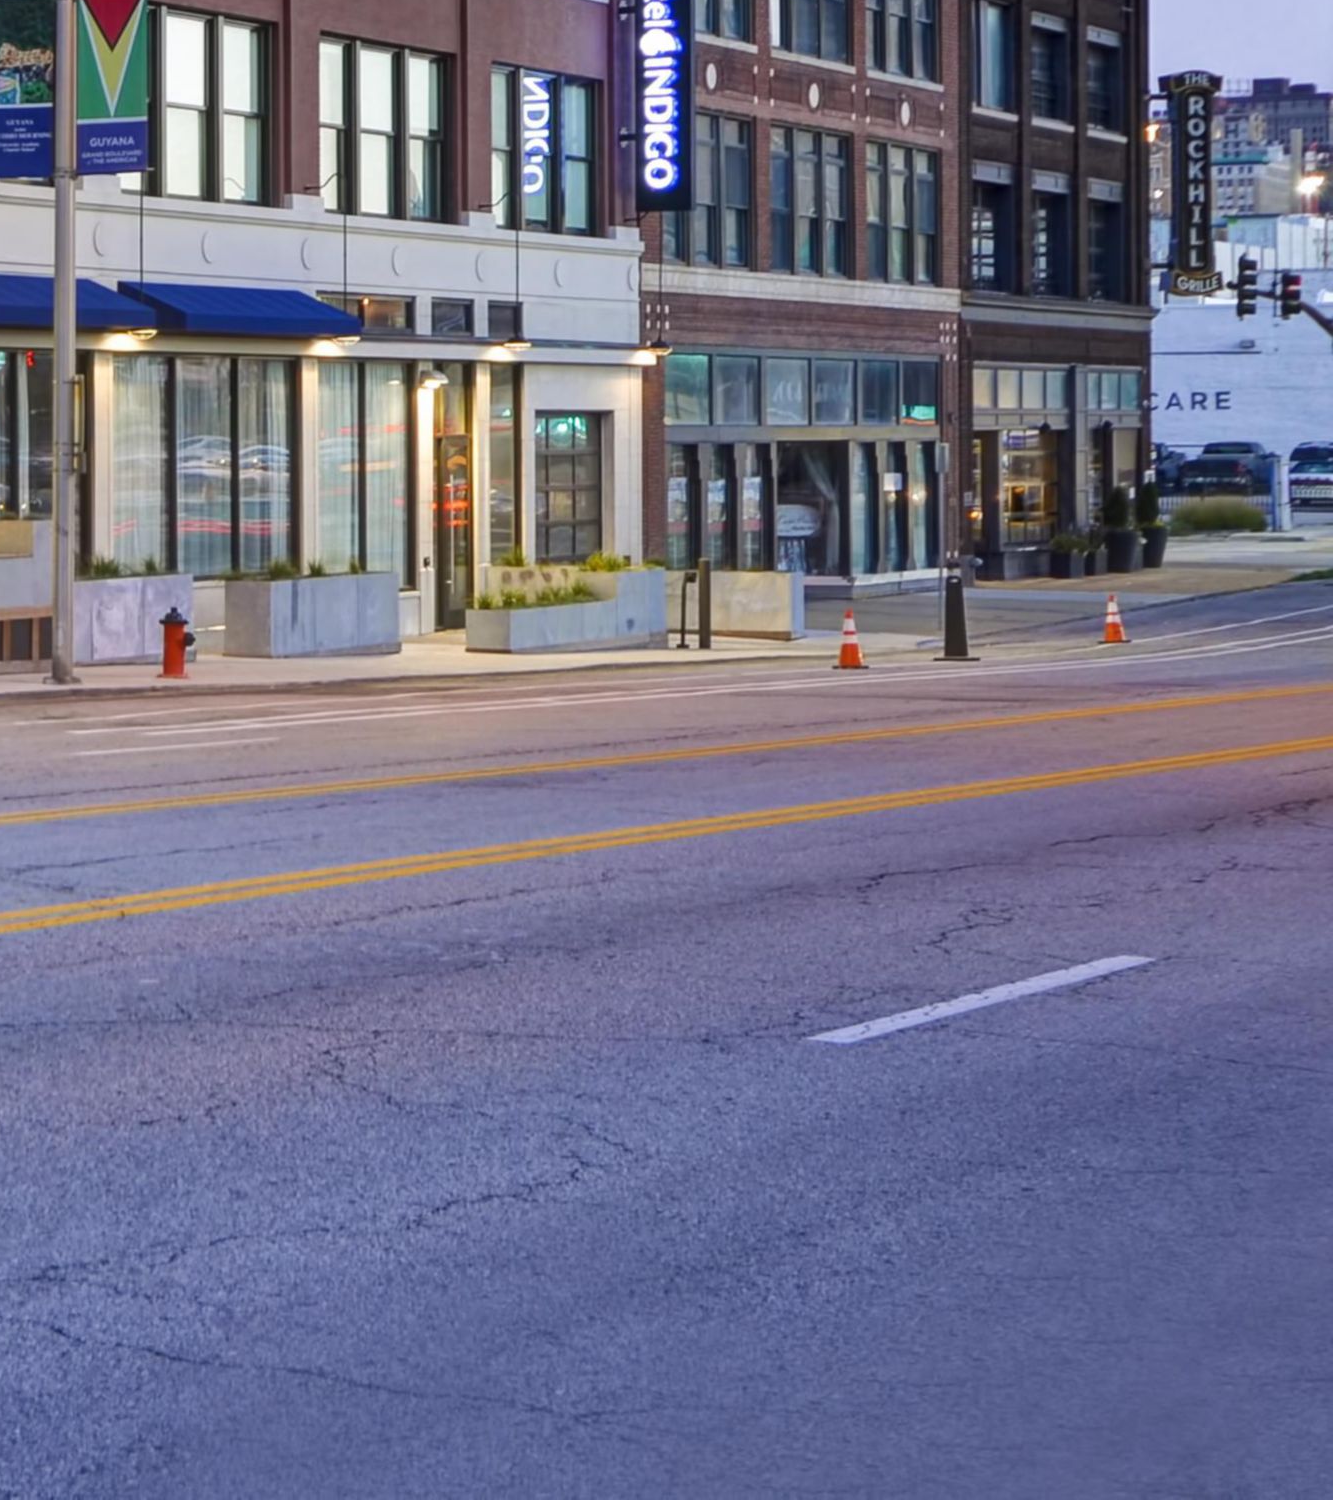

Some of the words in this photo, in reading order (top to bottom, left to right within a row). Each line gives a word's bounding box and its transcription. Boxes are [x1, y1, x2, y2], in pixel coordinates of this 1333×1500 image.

[1183, 71, 1211, 87] THE
[643, 57, 675, 190] INDIGO
[90, 136, 134, 148] GUYANA
[1187, 95, 1206, 268] ROCKHILL
[1176, 273, 1221, 293] GRILLE
